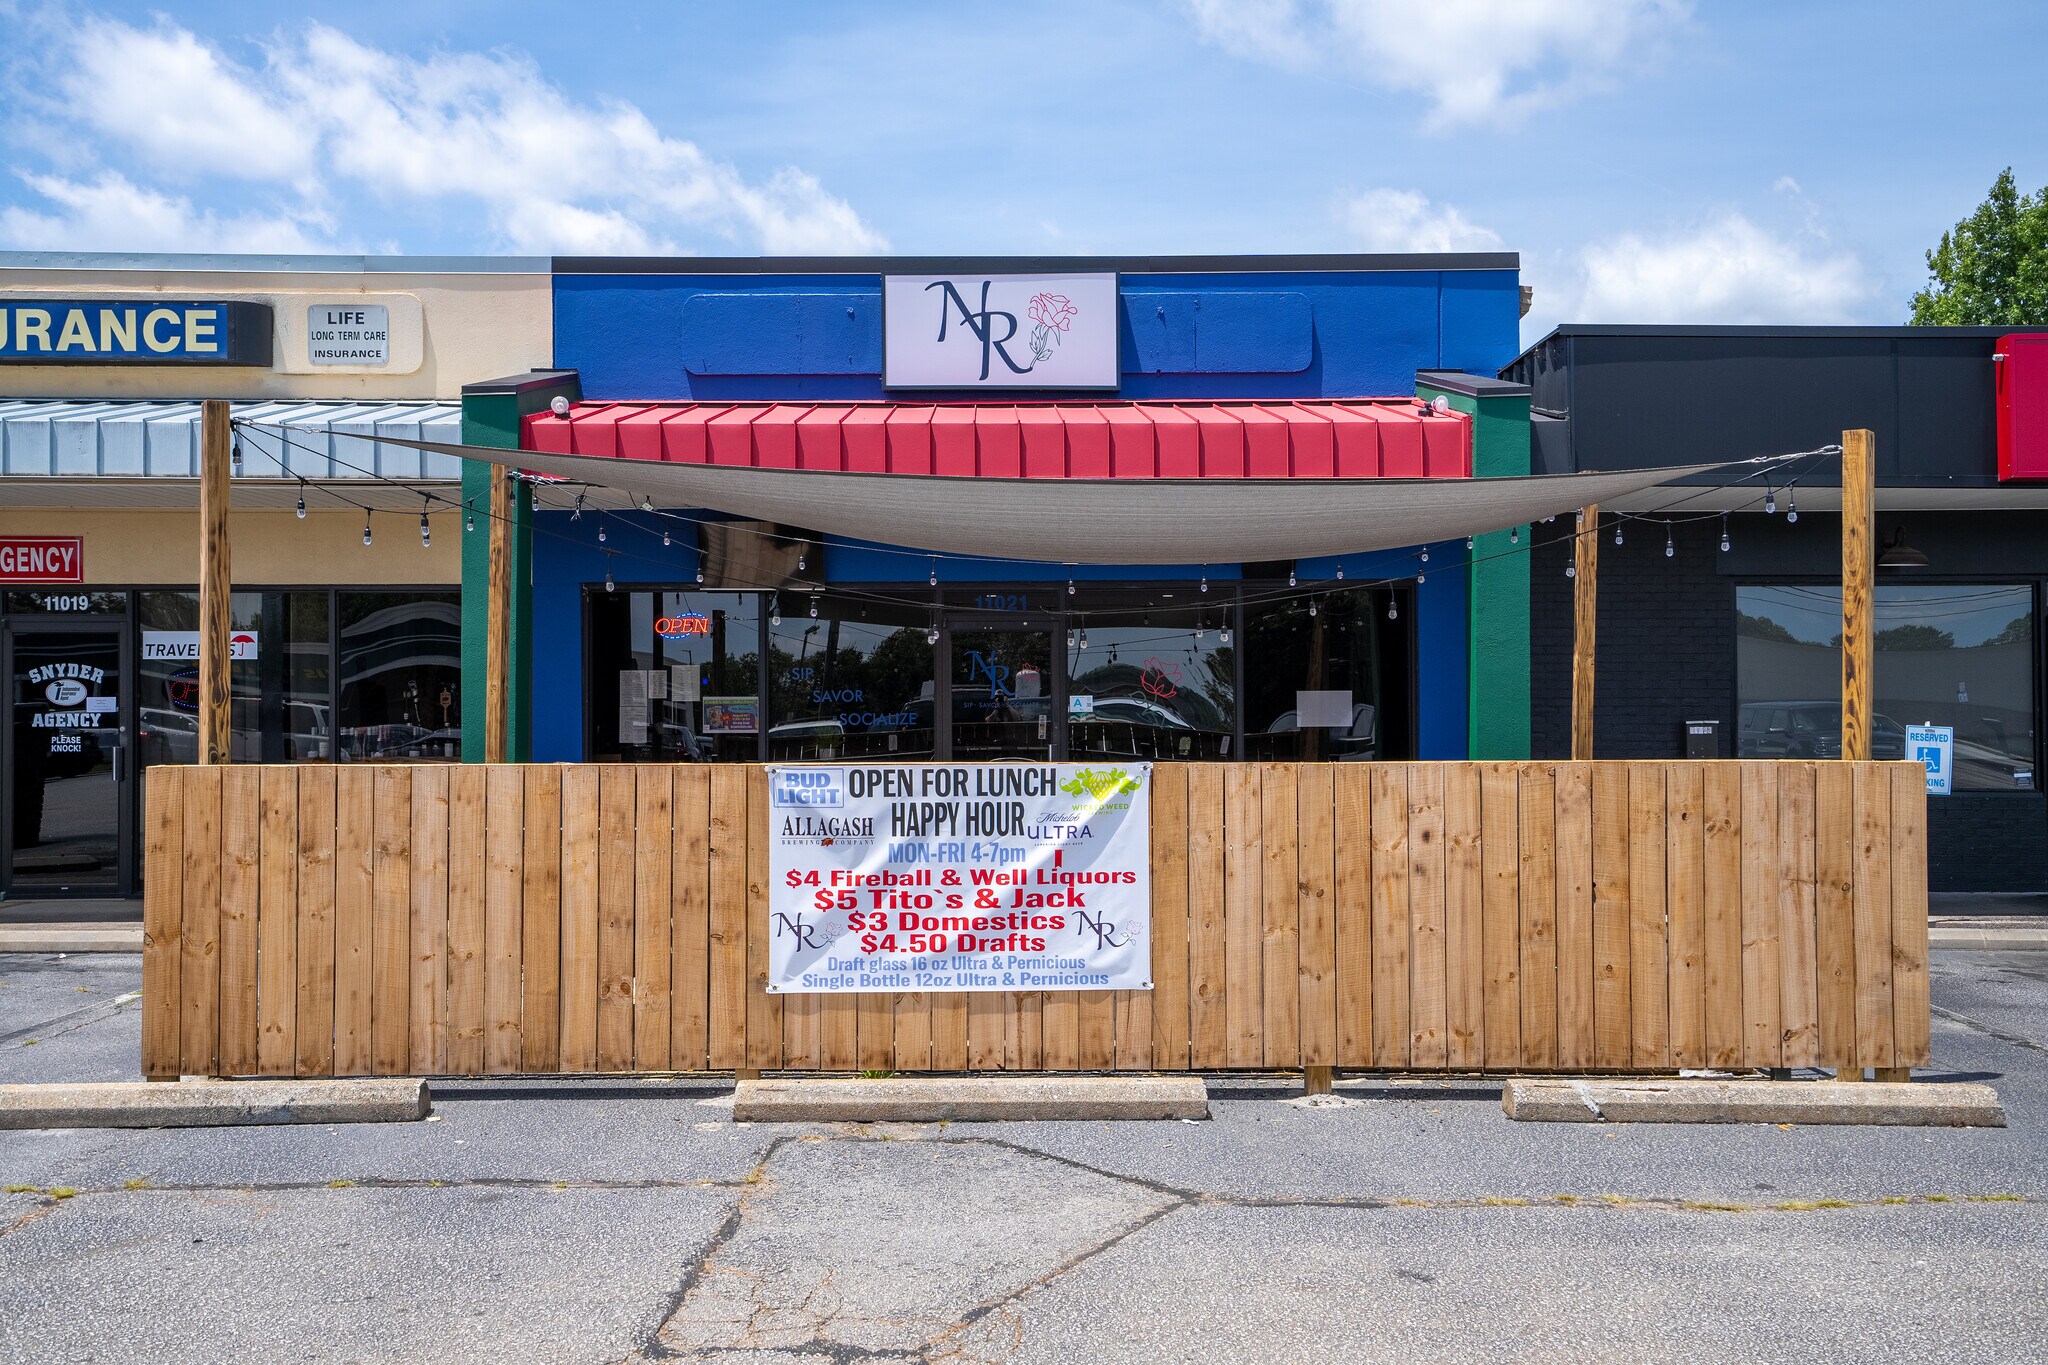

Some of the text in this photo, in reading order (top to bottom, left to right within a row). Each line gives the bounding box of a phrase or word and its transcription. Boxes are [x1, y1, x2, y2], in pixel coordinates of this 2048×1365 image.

[327, 312, 365, 324] LIFE
[0, 308, 218, 352] RANCE
[311, 331, 386, 341] LONG TERM CARE
[314, 350, 382, 358] INSURANCE
[44, 595, 89, 611] 11019
[975, 593, 1028, 612] 11021
[654, 617, 709, 634] OPEN
[145, 643, 236, 657] TRAVES
[28, 663, 105, 684] SNYDER
[791, 667, 814, 681] SIP
[812, 689, 864, 703] SAVOR
[1073, 698, 1083, 708] A
[31, 712, 102, 728] AGENCY
[839, 712, 917, 726] SOCIALIZE
[51, 736, 82, 744] PLEASE
[1909, 732, 1949, 743] RESERVED
[51, 744, 82, 752] KNOCK!
[785, 772, 831, 788] BUD
[848, 768, 1056, 798] OPEN FOR LUNCH
[1925, 778, 1945, 787] KING
[777, 788, 840, 804] LIGHT
[1072, 803, 1105, 811] WICKED
[781, 815, 874, 837] ALLAGASH
[891, 802, 1025, 837] HAPPY HOUR
[1036, 812, 1081, 824] Michelob
[1027, 825, 1093, 840] ULTRA
[888, 842, 1026, 867] MON-FRI 4-7pm
[785, 867, 1137, 889] $4 Fireball & Well Liquors
[813, 888, 858, 912] $5
[974, 888, 1001, 909] &
[1011, 887, 1086, 909] Jack
[847, 910, 1066, 934] $3 Domestics
[860, 932, 1046, 955] $4.50 Drafts
[827, 955, 1086, 974] Draft glass 16 oz Ultra & Pernicious
[802, 971, 1109, 990] Single Bottle 12oz Ultra & Pernicious
